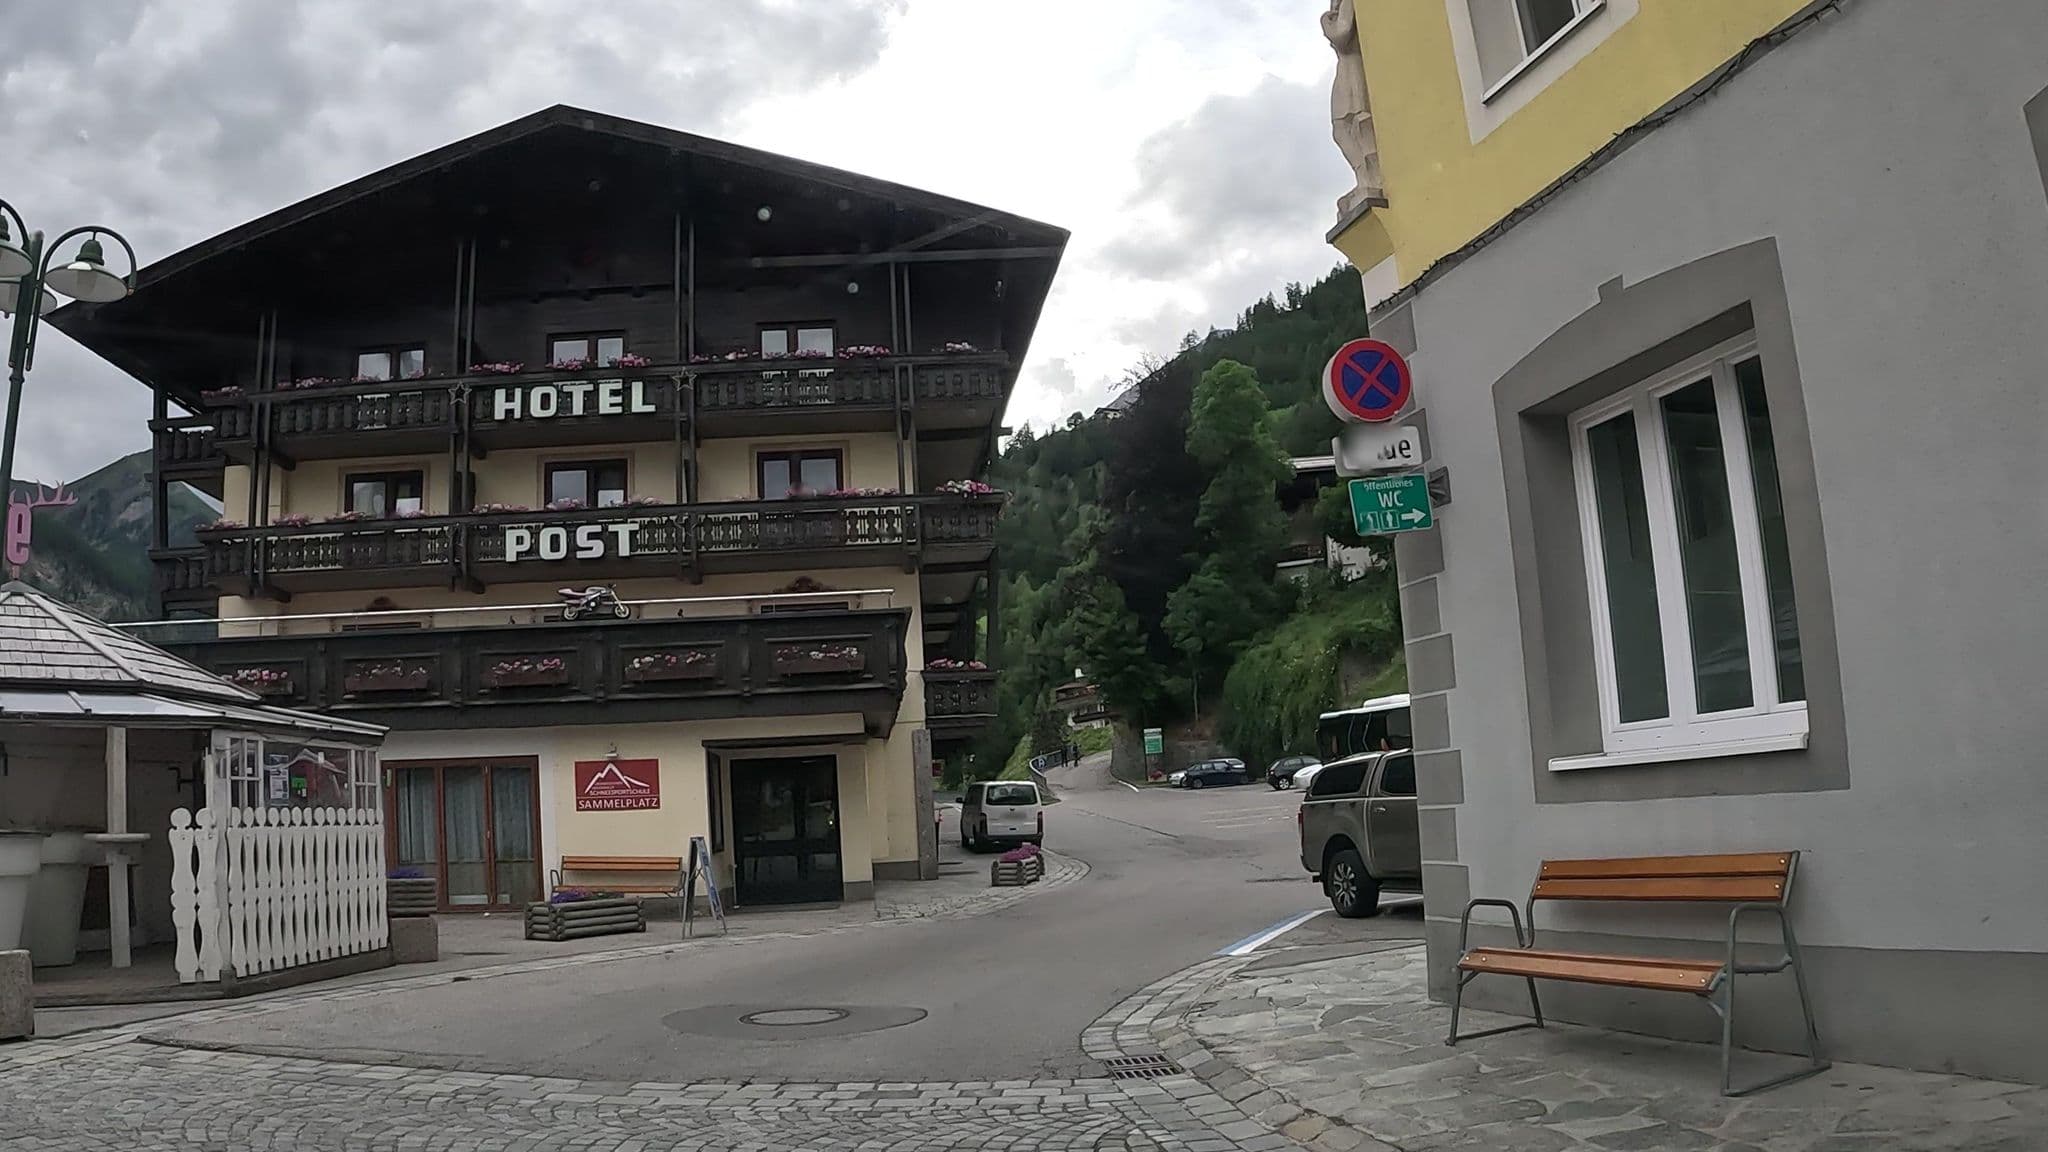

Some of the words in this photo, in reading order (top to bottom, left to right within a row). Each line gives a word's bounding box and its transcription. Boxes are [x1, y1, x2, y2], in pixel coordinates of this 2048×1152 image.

[494, 381, 656, 420] HOTEL
[1378, 491, 1404, 508] WC
[505, 523, 639, 562] POST
[578, 797, 658, 809] SAMMELPLATZ
